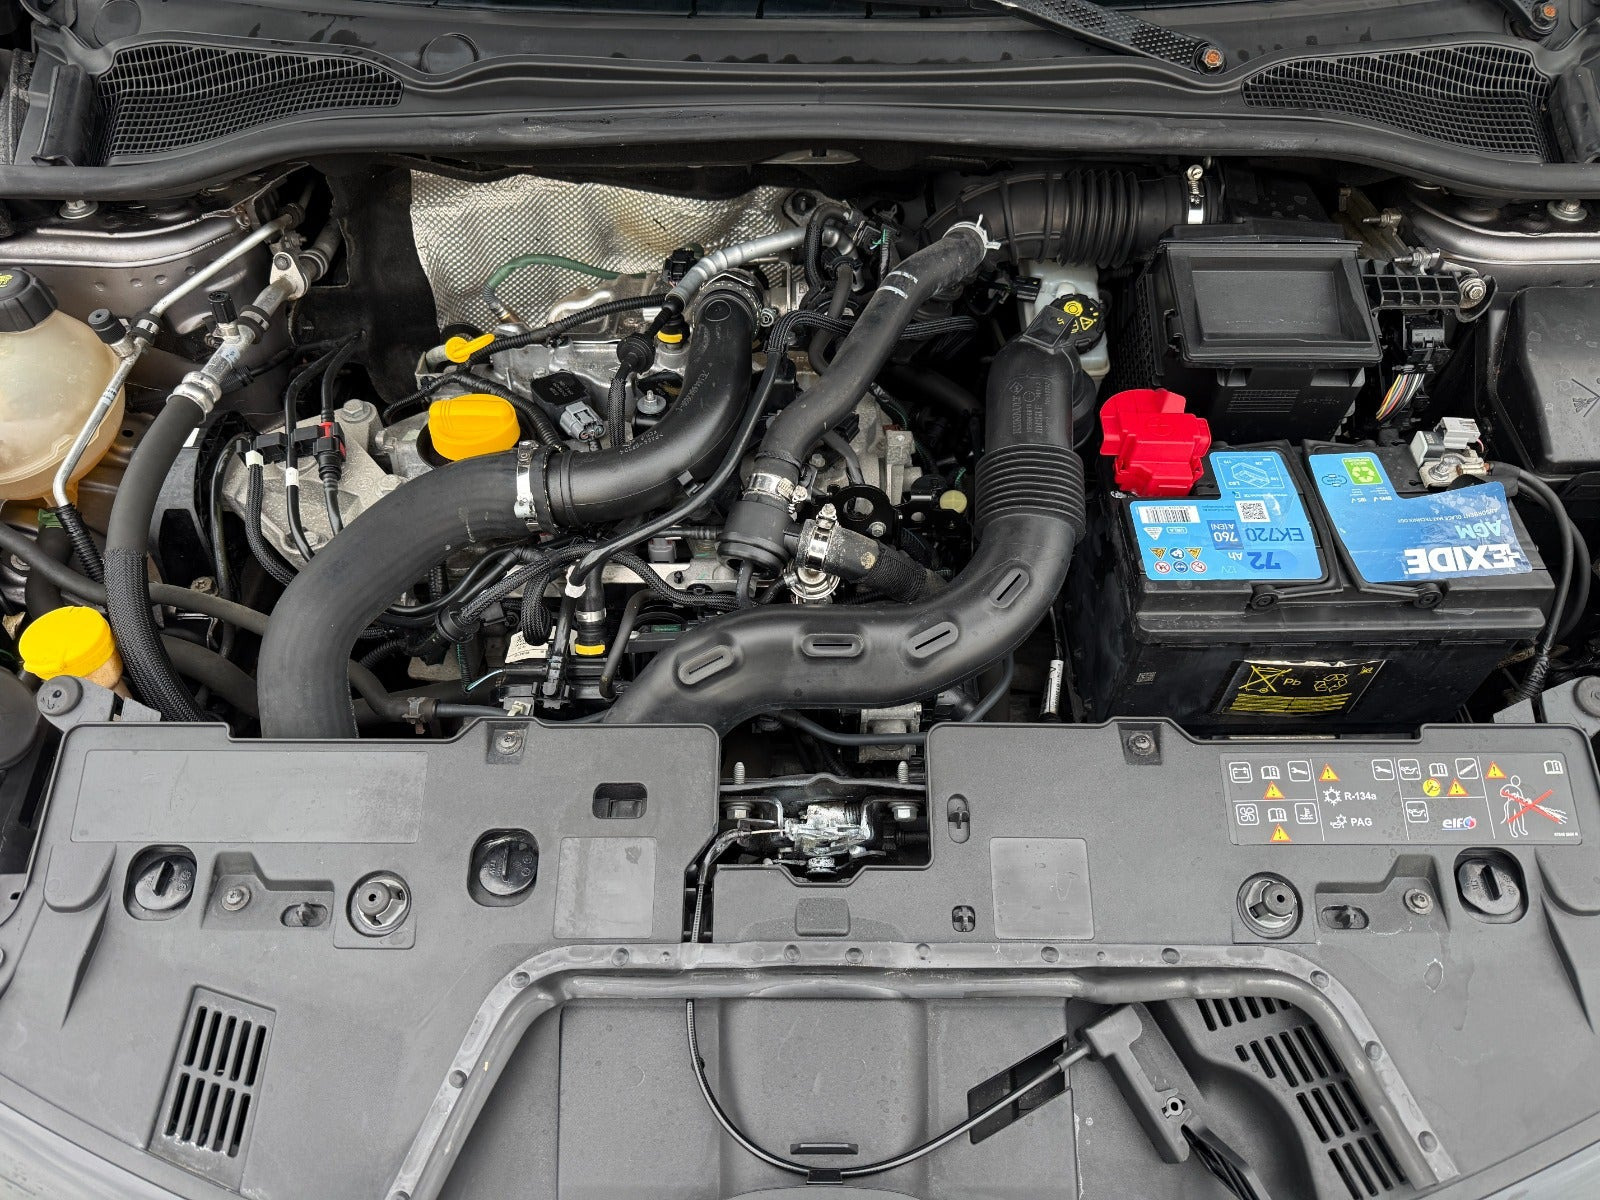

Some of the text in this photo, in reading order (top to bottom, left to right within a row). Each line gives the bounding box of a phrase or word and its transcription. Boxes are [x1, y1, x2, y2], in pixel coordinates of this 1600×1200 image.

[1245, 527, 1304, 542] EK720
[1454, 519, 1502, 539] AGM
[1213, 531, 1238, 543] 760
[1228, 552, 1243, 561] Ah
[1247, 551, 1281, 570] 72
[1404, 544, 1520, 574] EXIDE
[1283, 678, 1302, 686] Pb
[1344, 791, 1377, 800] R-134a
[1350, 817, 1373, 827] PAG
[1442, 817, 1464, 829] elf
